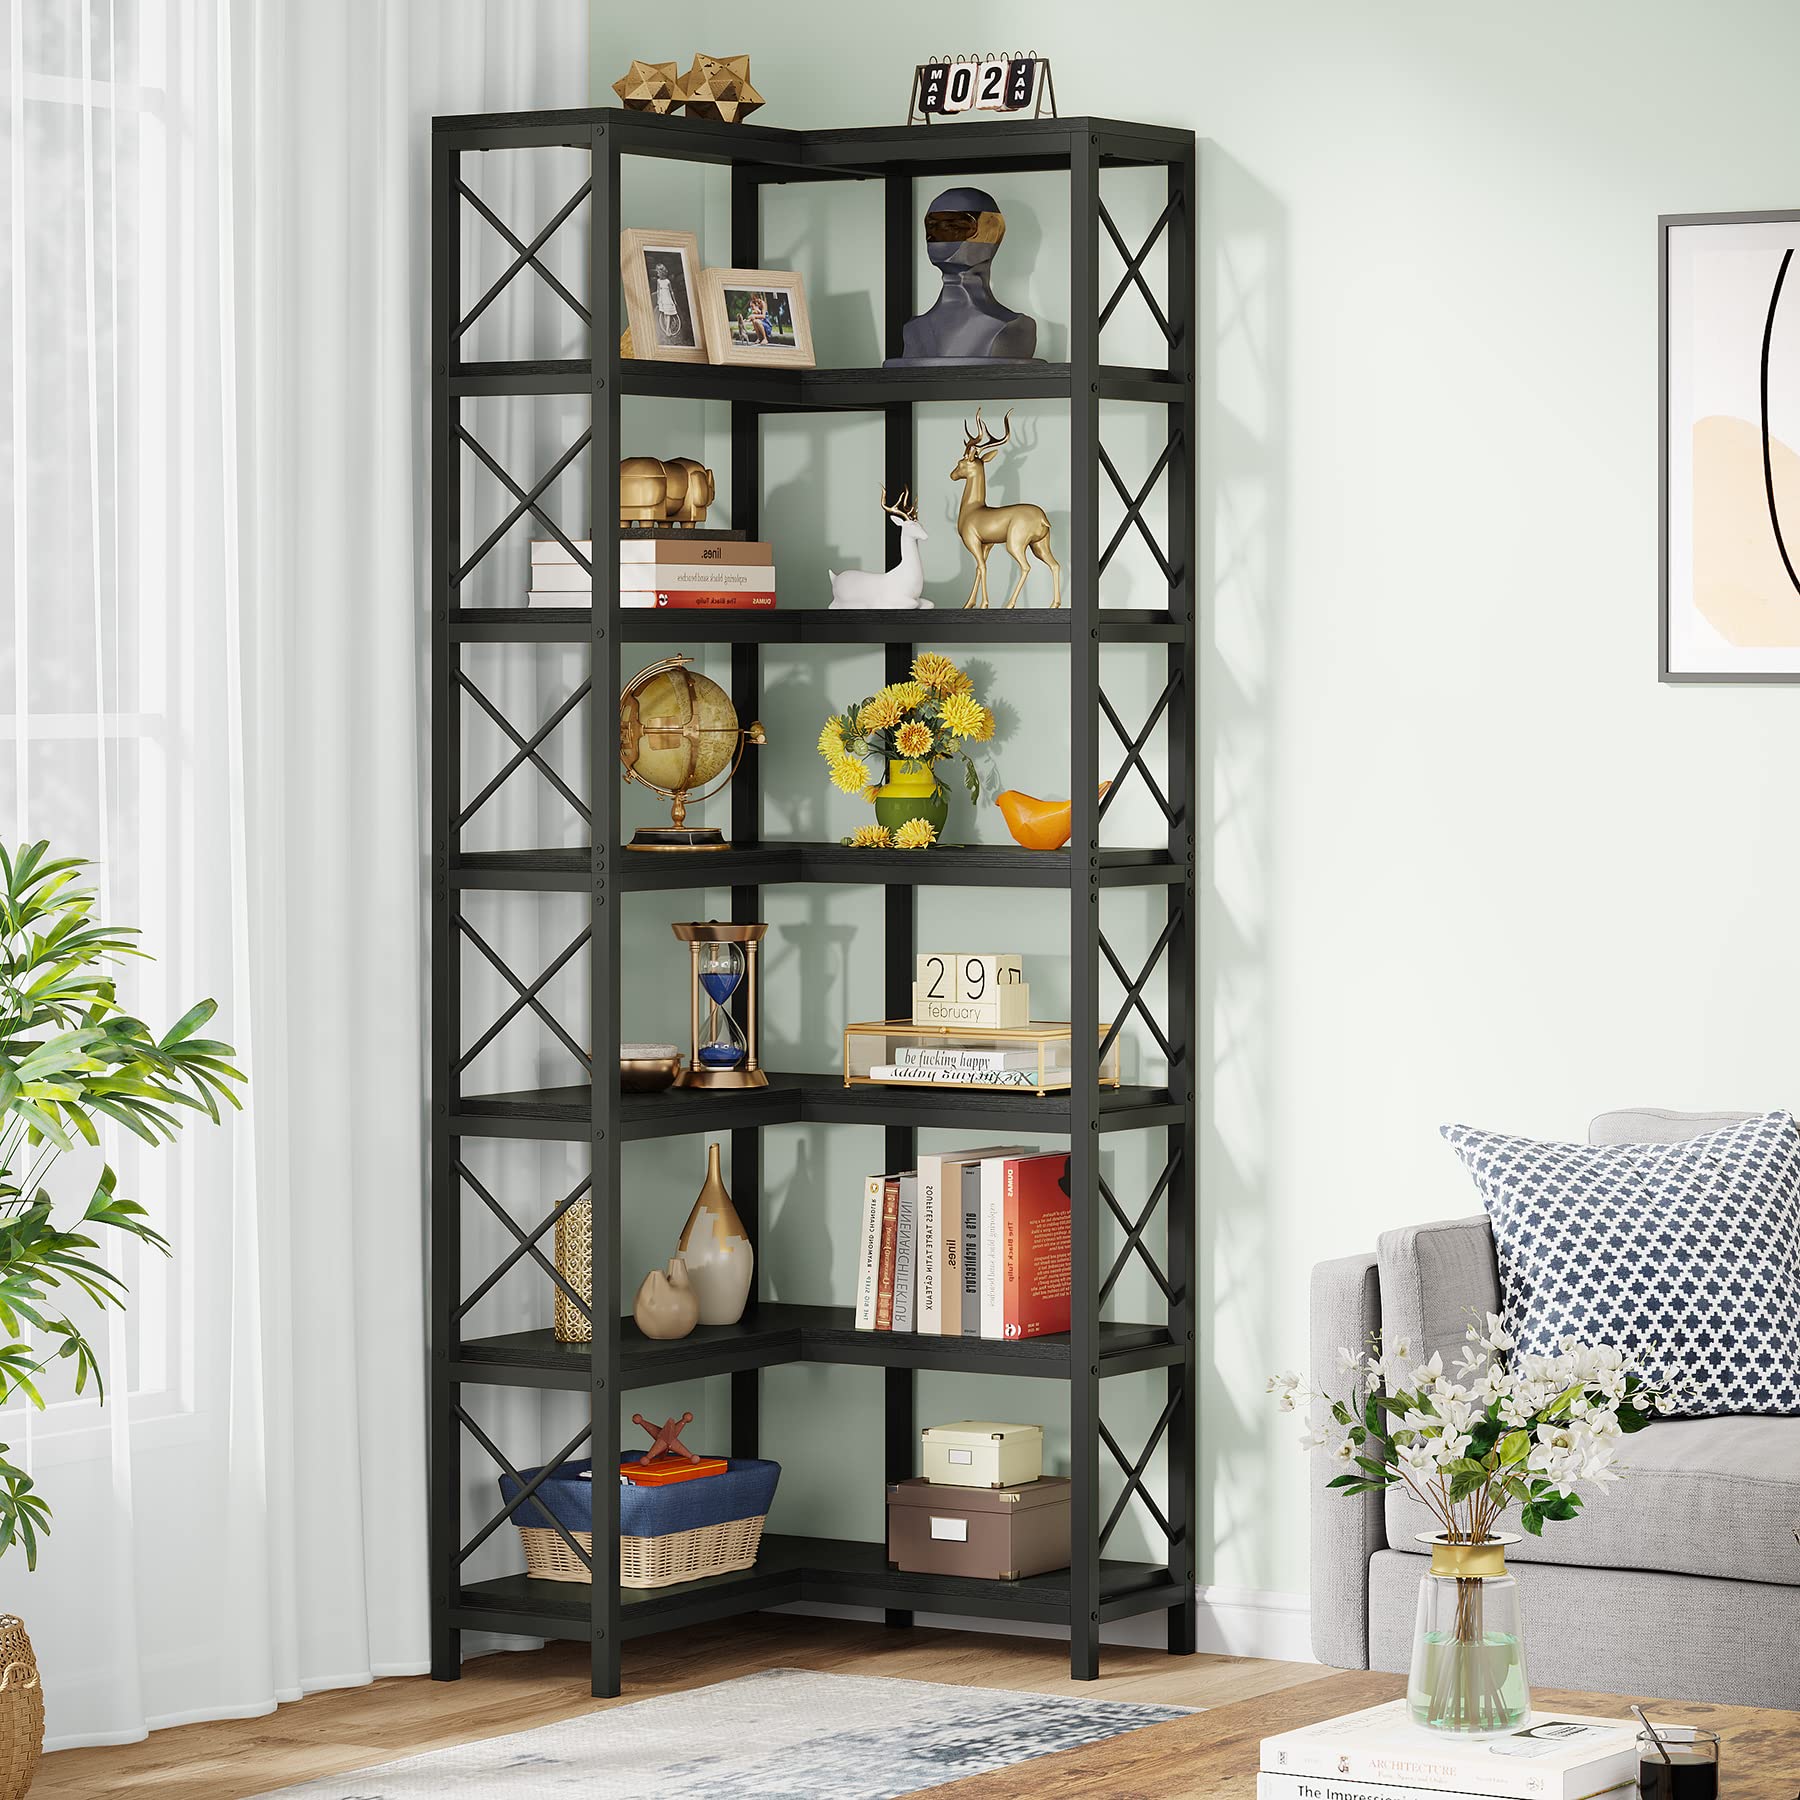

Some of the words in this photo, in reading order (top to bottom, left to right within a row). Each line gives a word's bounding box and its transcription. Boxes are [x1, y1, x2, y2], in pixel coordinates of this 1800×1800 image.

[927, 69, 943, 106] MAR
[1014, 64, 1026, 101] JAN
[928, 1002, 981, 1023] february
[904, 1049, 915, 1065] be
[919, 1050, 957, 1070] fucking
[960, 1052, 991, 1071] happy
[890, 1068, 937, 1082] happy
[1368, 1758, 1457, 1777] ARCHITECTURE
[1297, 1785, 1322, 1798] The
